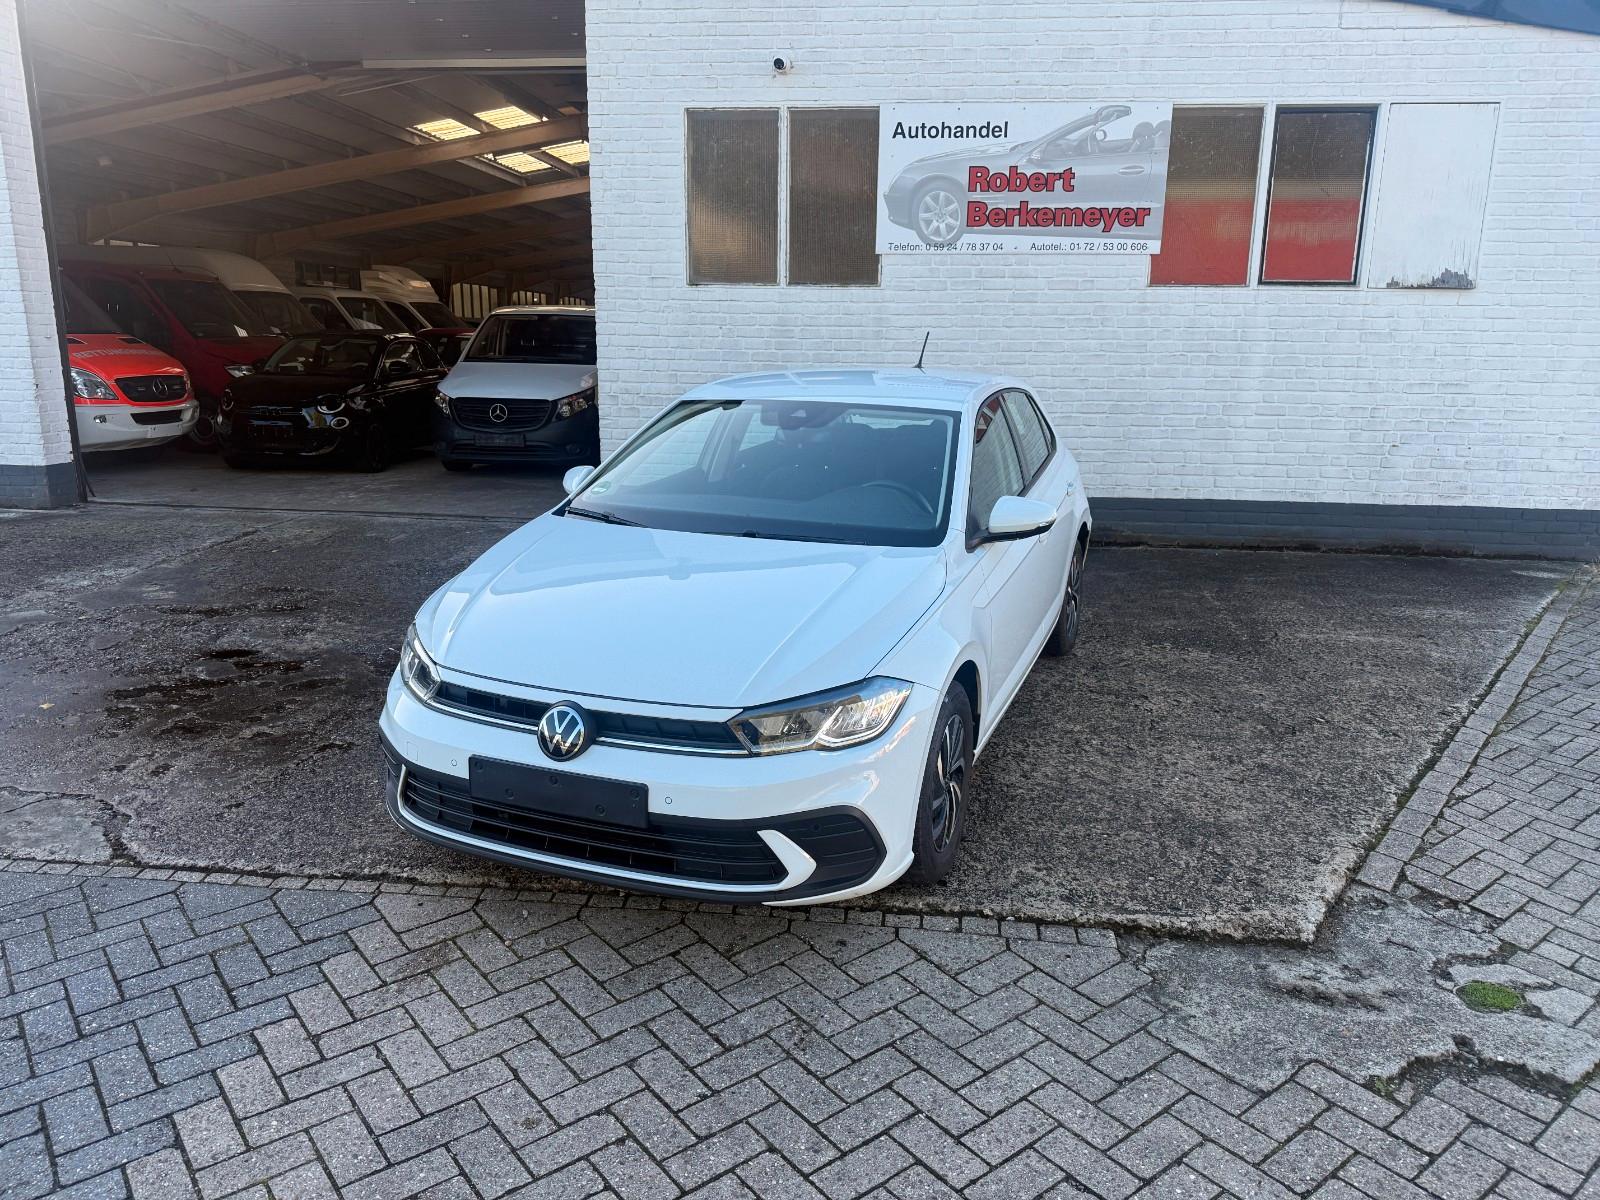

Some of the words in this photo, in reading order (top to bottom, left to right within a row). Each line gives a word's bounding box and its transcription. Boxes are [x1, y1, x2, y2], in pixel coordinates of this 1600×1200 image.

[892, 121, 1009, 139] Autohandel
[968, 166, 1075, 192] Robert
[966, 201, 1152, 232] Berkemeyer
[888, 242, 923, 251] Telefon:
[925, 243, 931, 251] 0
[933, 243, 945, 251] 59
[946, 243, 957, 251] 24
[966, 243, 977, 251] 78
[979, 243, 990, 251] 37
[992, 243, 1004, 251] 04
[1030, 242, 1067, 251] Autotel.:
[1069, 243, 1080, 251] 01
[1083, 243, 1095, 251] 72
[1102, 243, 1114, 251] 53
[1116, 243, 1128, 251] 00
[1130, 242, 1148, 251] 606
